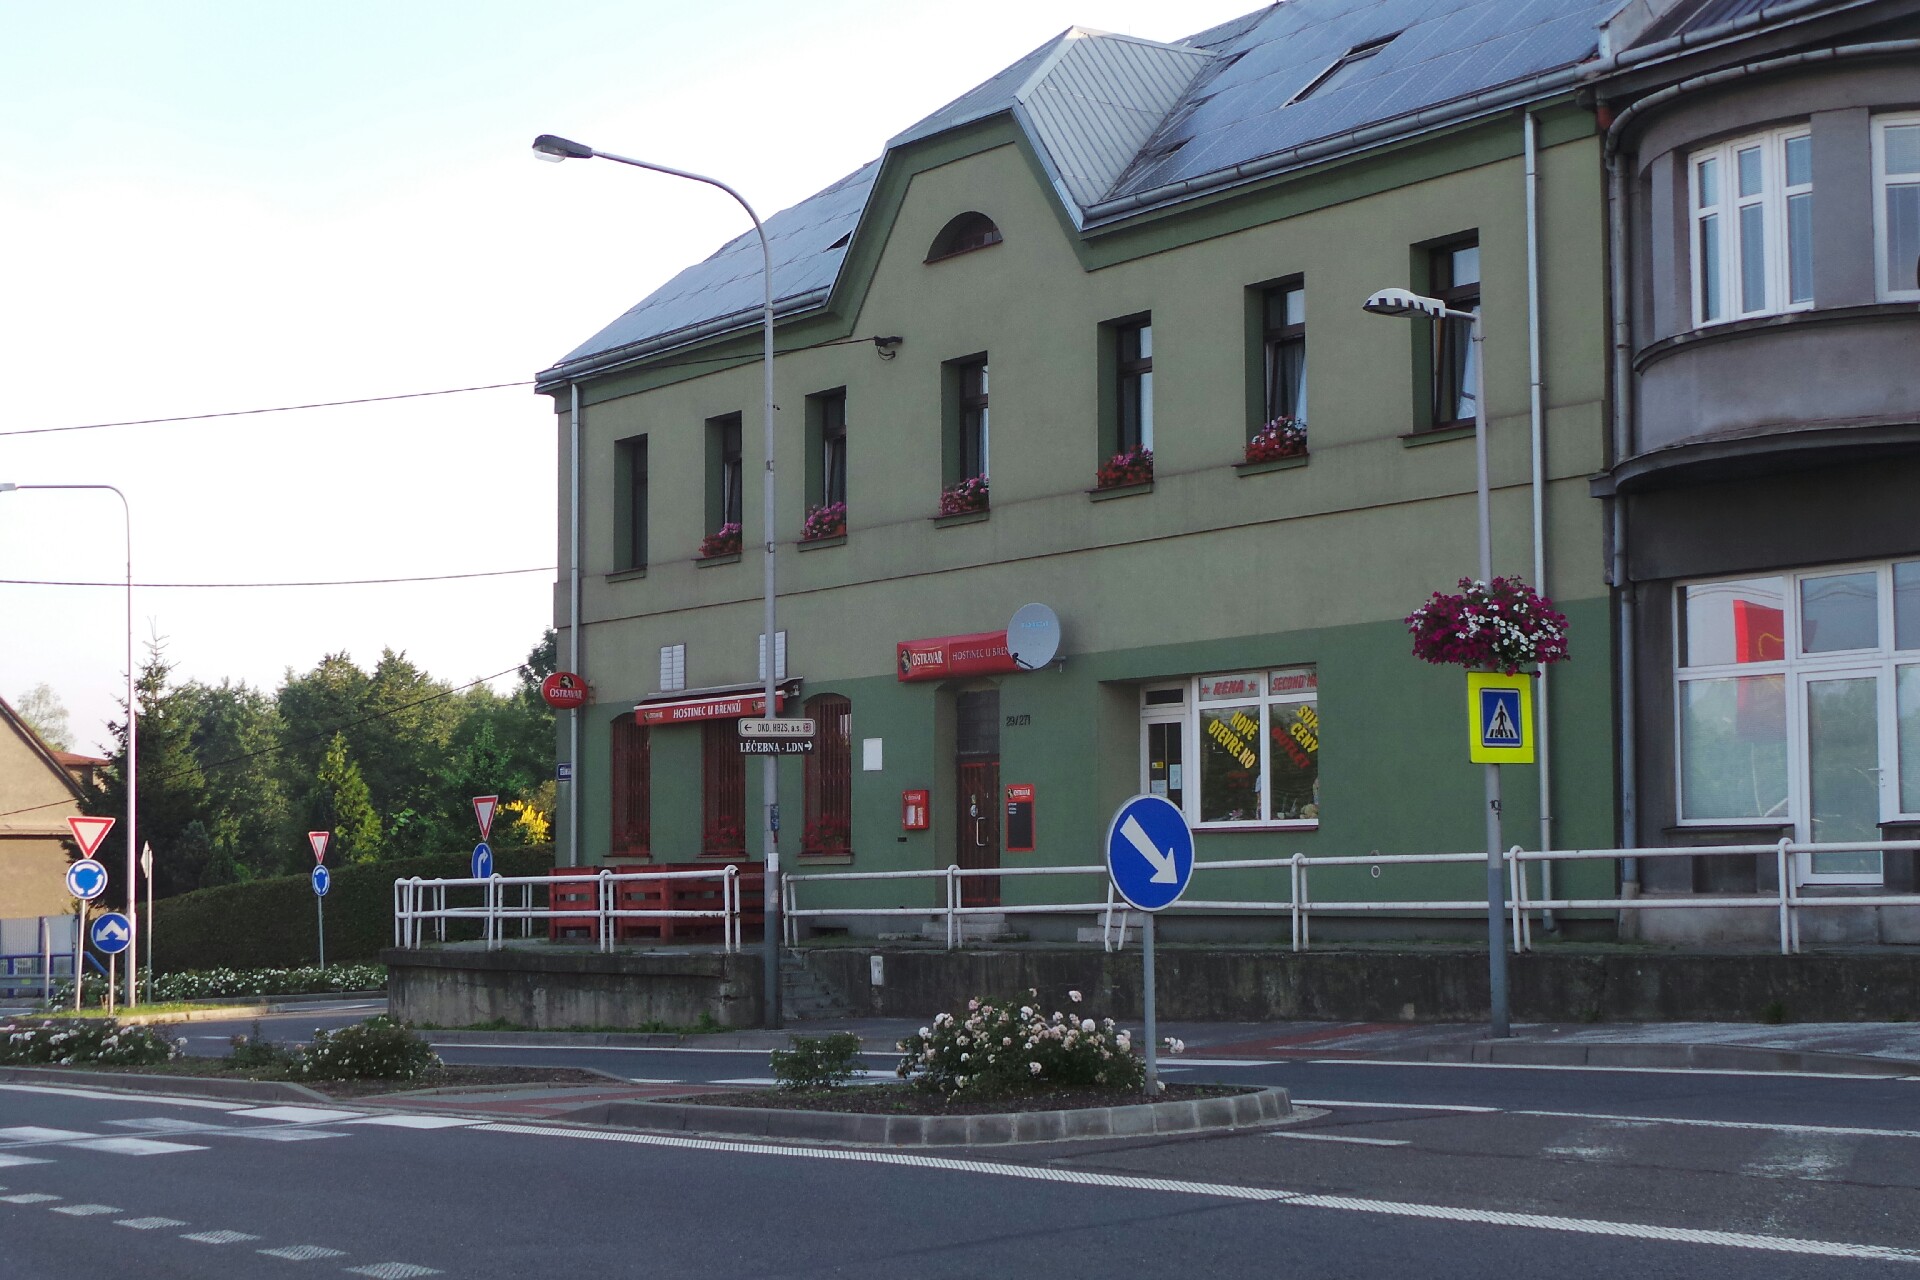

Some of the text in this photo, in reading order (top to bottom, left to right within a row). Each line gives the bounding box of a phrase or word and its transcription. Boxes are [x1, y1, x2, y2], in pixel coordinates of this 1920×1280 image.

[912, 650, 943, 666] OSTRAVAR
[952, 648, 984, 661] HOSTINEC
[985, 648, 991, 657] U
[1272, 675, 1306, 691] SECOND
[549, 688, 583, 700] OSTRAVAR
[673, 706, 706, 719] HOSTINEC
[707, 705, 714, 716] U
[715, 700, 741, 715] BŘENKŮ
[1006, 714, 1031, 727] 29/271
[1290, 722, 1319, 752] CENY
[739, 740, 780, 753] LÉČEBNA
[785, 742, 804, 753] LDN
